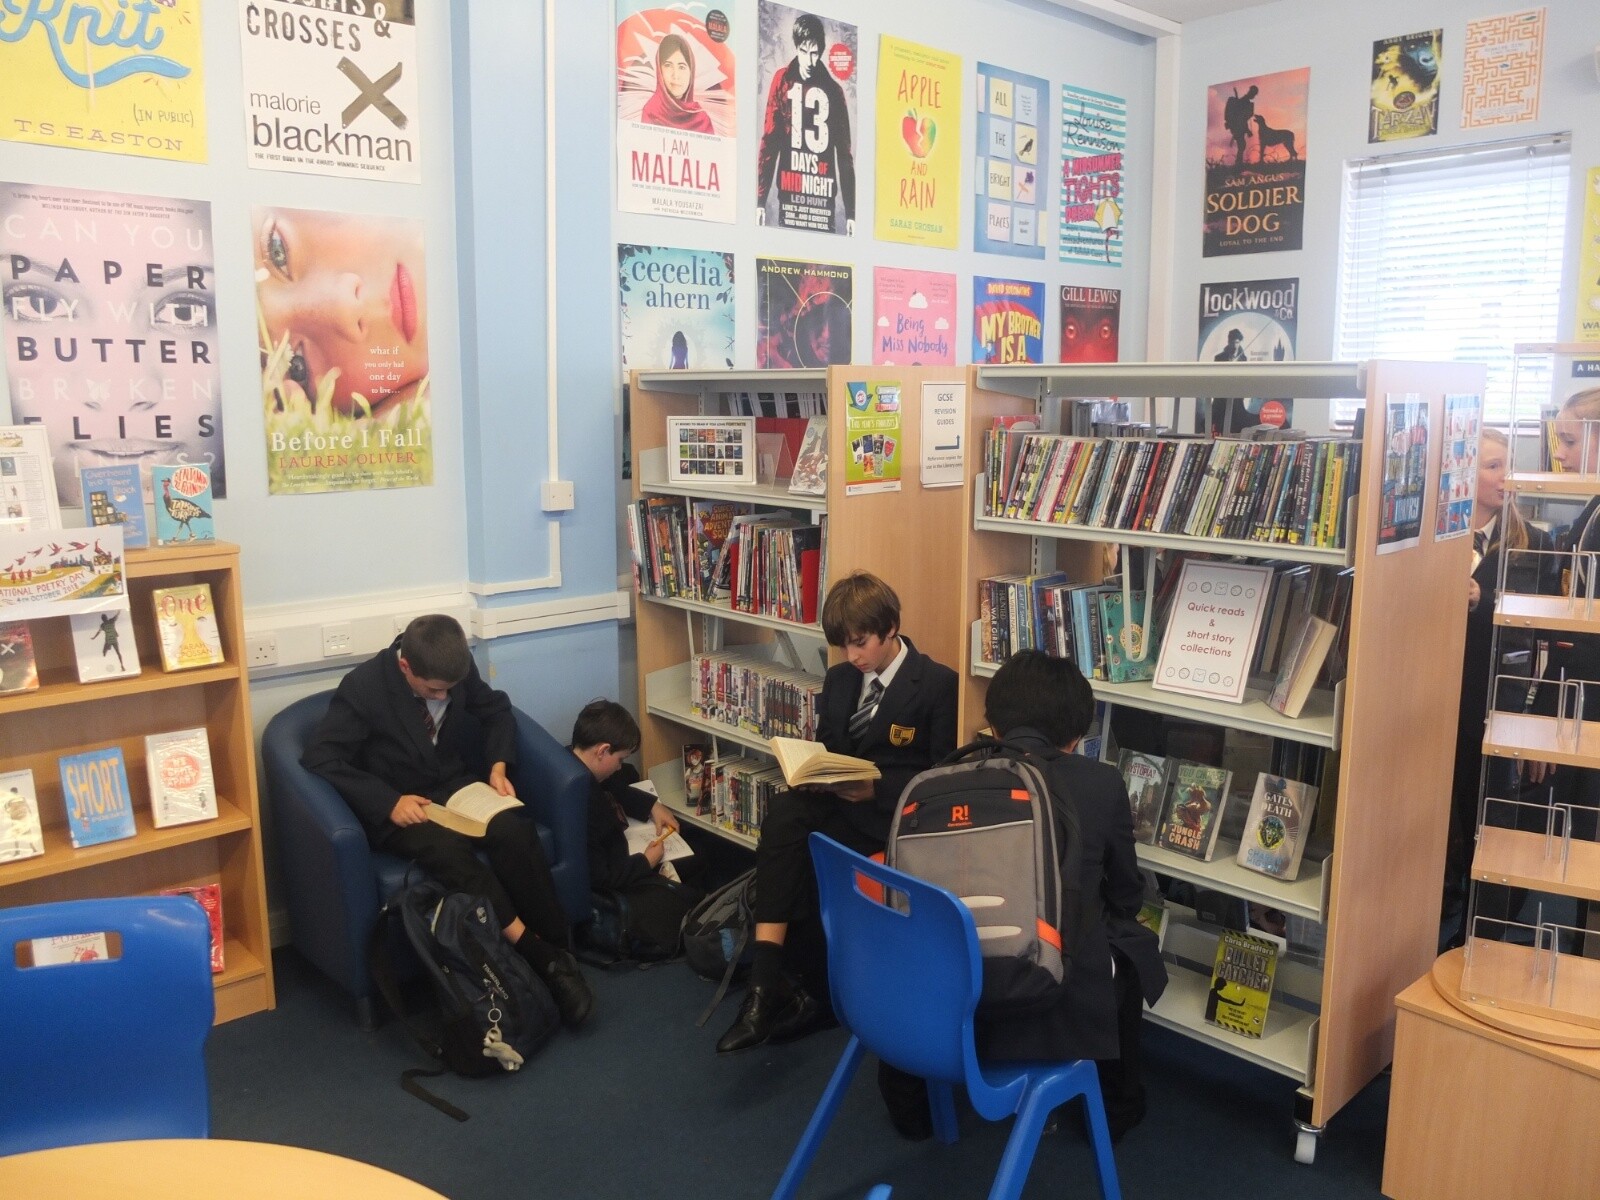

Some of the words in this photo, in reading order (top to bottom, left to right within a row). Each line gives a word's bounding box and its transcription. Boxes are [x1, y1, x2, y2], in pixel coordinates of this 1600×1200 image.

[246, 4, 362, 52] CROSSES
[898, 69, 941, 108] APPLE
[995, 91, 1008, 107] ALL
[250, 90, 321, 116] malorie
[132, 102, 153, 124] (IN
[157, 109, 194, 128] PUBLIC)
[787, 82, 830, 153] 13
[1074, 101, 1112, 133] Louise
[1371, 98, 1437, 139] TARZAN
[66, 125, 184, 151] EASTON
[252, 115, 413, 163] blackman
[662, 137, 666, 153] I
[671, 138, 689, 156] AM
[995, 132, 1006, 147] THE
[1063, 121, 1121, 151] Rennison
[632, 150, 720, 191] MALALA
[791, 150, 819, 175] DAYS
[818, 161, 829, 175] OF
[911, 161, 928, 176] AND
[781, 170, 834, 198] MIDNIGHT
[990, 173, 1010, 188] BRIGHT
[1064, 172, 1120, 205] TIGHTS
[1225, 179, 1245, 187] SAM
[1249, 174, 1284, 185] ANGUS
[652, 198, 673, 206] MALALA
[791, 194, 805, 204] LEO
[807, 197, 828, 207] HUNT
[900, 178, 936, 211] RAIN
[1207, 186, 1302, 214] SOLDIER
[4, 214, 98, 243] CAN
[123, 223, 204, 251] YOU
[989, 213, 1010, 229] PLACES
[1226, 212, 1280, 235] DOG
[10, 254, 207, 290] PAPER
[631, 255, 722, 287] cecelia
[761, 265, 800, 275] ANDREW
[804, 268, 849, 279] HAMMOND
[646, 283, 711, 310] ahern
[1062, 287, 1085, 302] GILL
[1088, 288, 1118, 303] LEWIS
[11, 296, 79, 323] FLY
[106, 300, 210, 327] WITH
[896, 312, 925, 337] Being
[981, 311, 1007, 348] MY
[1008, 311, 1041, 340] BROTHER
[17, 336, 212, 365] BUTTER
[370, 346, 390, 355] what
[393, 346, 400, 355] if
[882, 335, 904, 352] Miss
[908, 334, 948, 357] Nobody
[1001, 335, 1014, 363] IS
[1017, 335, 1027, 360] A
[364, 362, 377, 370] you
[378, 361, 392, 370] only
[387, 372, 401, 383] day
[937, 393, 954, 402] GCSE
[24, 415, 216, 440] LIES
[271, 431, 353, 451] Before
[361, 430, 369, 448] I
[378, 428, 423, 448] Fall
[280, 455, 349, 469] LAUREN
[356, 452, 419, 465] OLIVER
[106, 478, 131, 487] Tower
[112, 486, 136, 494] Block
[0, 586, 33, 597] ATIONAL
[36, 579, 66, 593] POETRY
[69, 571, 85, 583] DAY
[30, 590, 61, 601] OCTOBER
[62, 582, 80, 594] 2018
[161, 594, 206, 617] One
[1187, 602, 1216, 614] Quick
[1217, 607, 1245, 617] reads
[1208, 619, 1215, 627] &
[1186, 630, 1210, 640] short
[1212, 633, 1235, 645] story
[1180, 643, 1232, 658] collections
[66, 757, 124, 819] SHORT
[1264, 791, 1293, 807] GATES
[952, 805, 969, 821] R!
[1260, 802, 1292, 818] DEATH
[1168, 832, 1201, 850] CRASH
[1171, 824, 1202, 840] JUNGLE
[1224, 935, 1242, 946] Chris
[1243, 941, 1274, 956] Bradford
[1224, 946, 1269, 974] BULLET
[1216, 961, 1270, 993] CATCHER
